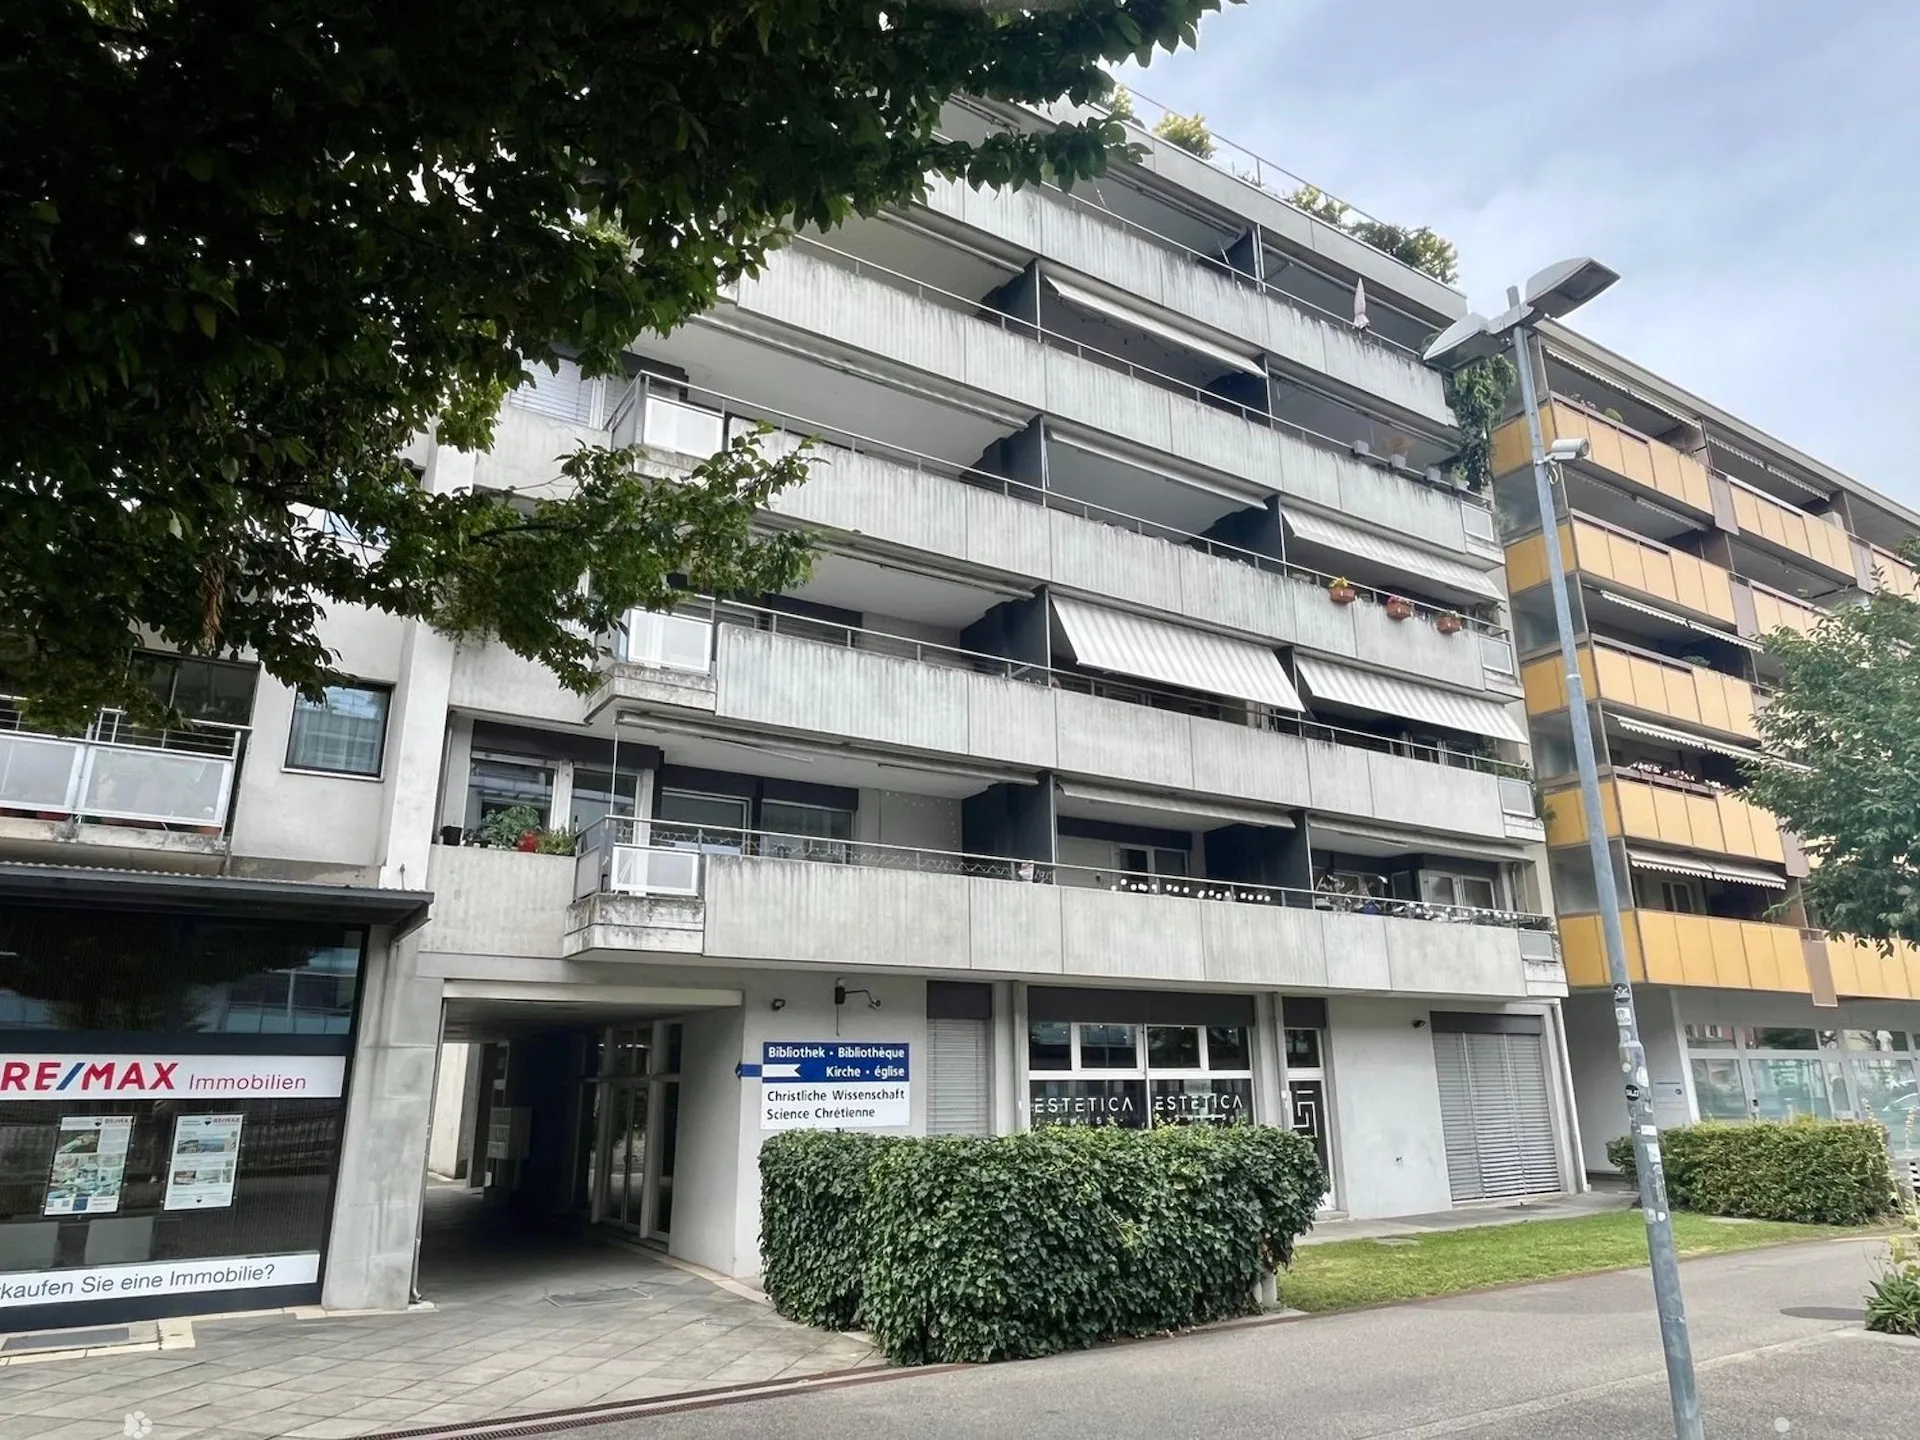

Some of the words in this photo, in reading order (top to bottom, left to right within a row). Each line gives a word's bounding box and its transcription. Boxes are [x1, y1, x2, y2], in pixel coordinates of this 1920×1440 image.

[768, 1046, 826, 1058] Bibliothek
[838, 1046, 905, 1060] Bibliothèque
[0, 1062, 178, 1091] RE/MAX
[189, 1074, 306, 1091] Immobilien
[826, 1065, 861, 1077] Kirche
[874, 1065, 905, 1079] église
[767, 1090, 827, 1102] Christliche
[832, 1088, 905, 1101] Wissenschaft
[1034, 1097, 1134, 1113] ESTETICA
[1155, 1095, 1243, 1110] ESTETICA
[766, 1108, 810, 1120] Science
[814, 1107, 875, 1119] Chrétienne
[0, 1279, 74, 1299] kaufen
[81, 1275, 114, 1293] Sie
[121, 1273, 163, 1290] eine
[169, 1263, 275, 1286] Immobilie?
